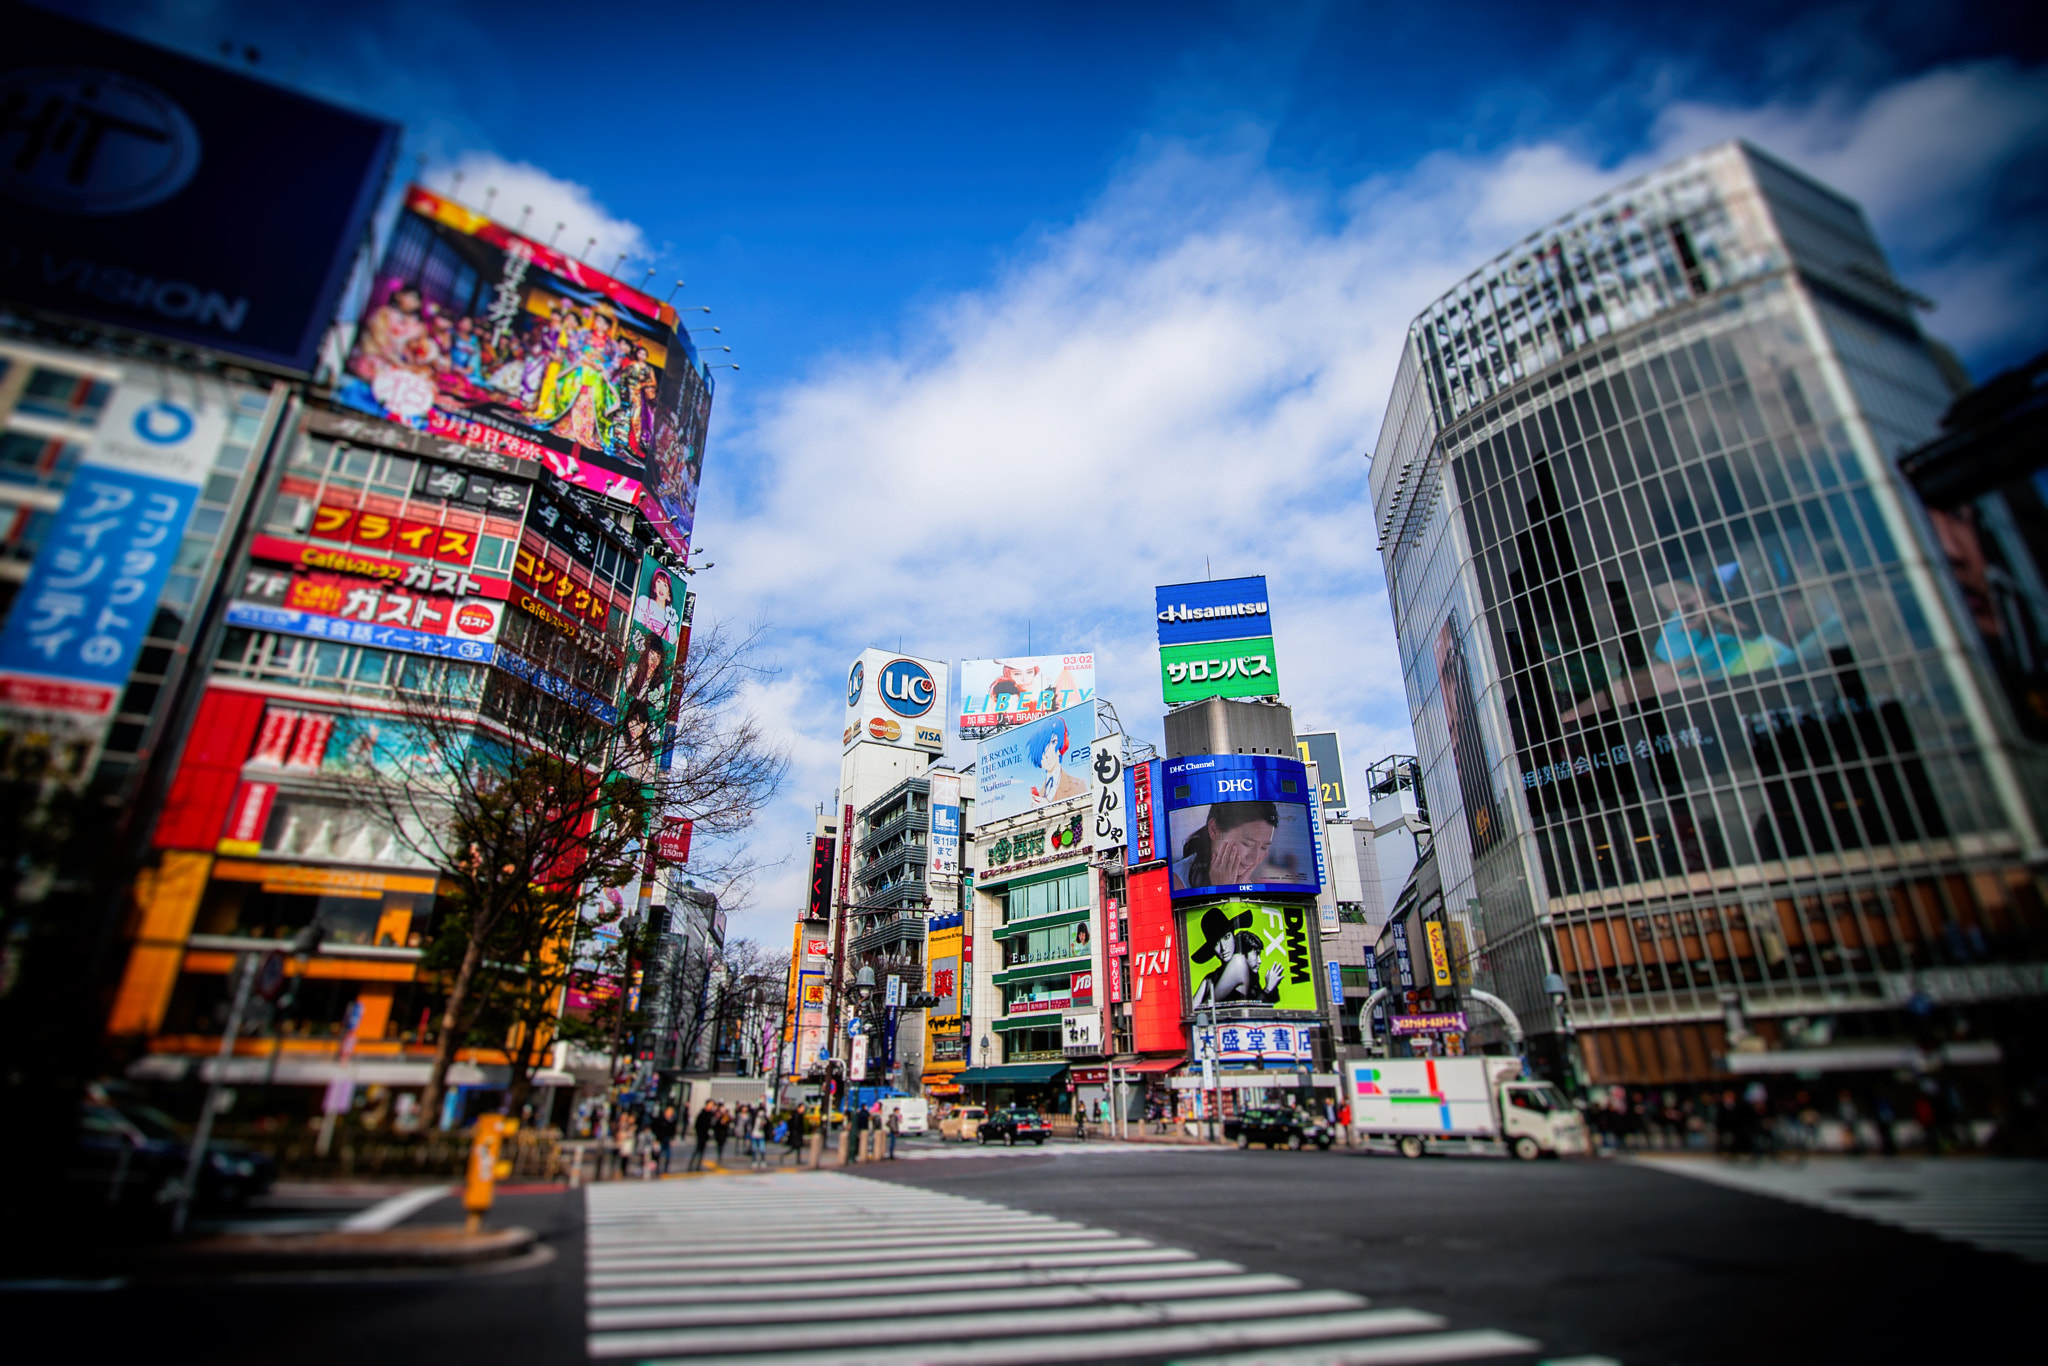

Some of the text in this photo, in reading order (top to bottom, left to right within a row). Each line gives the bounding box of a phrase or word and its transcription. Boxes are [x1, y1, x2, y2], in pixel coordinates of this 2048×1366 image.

[41, 250, 252, 333] VISION
[315, 506, 469, 557] プライス
[403, 564, 480, 596] ガスト
[515, 548, 605, 619] コンタクト
[341, 587, 443, 629] ガスト
[1158, 601, 1268, 622] Hisamitsu
[459, 616, 491, 628] ガスト
[305, 616, 452, 652] 英会話イーオン
[1064, 664, 1093, 672] RELEASE
[1167, 655, 1272, 683] サロンパス
[963, 687, 1094, 714] LIBERTY
[918, 731, 941, 743] VISA
[997, 754, 1023, 770] MOVIE
[1170, 760, 1215, 774] DHC Channel
[1094, 748, 1123, 843] もんじゃ
[1218, 779, 1253, 793] DHC
[1322, 782, 1341, 802] 21
[933, 835, 957, 847] 夜11時
[937, 846, 952, 857] まで
[663, 848, 684, 858] 150m
[944, 860, 957, 871] 地下
[1261, 906, 1287, 957] FX
[1012, 946, 1067, 963] Euphoria
[1283, 907, 1310, 984] DMM
[934, 968, 953, 998] 薬
[1073, 974, 1092, 993] JTB
[1366, 953, 1383, 1019] 洋服の山
